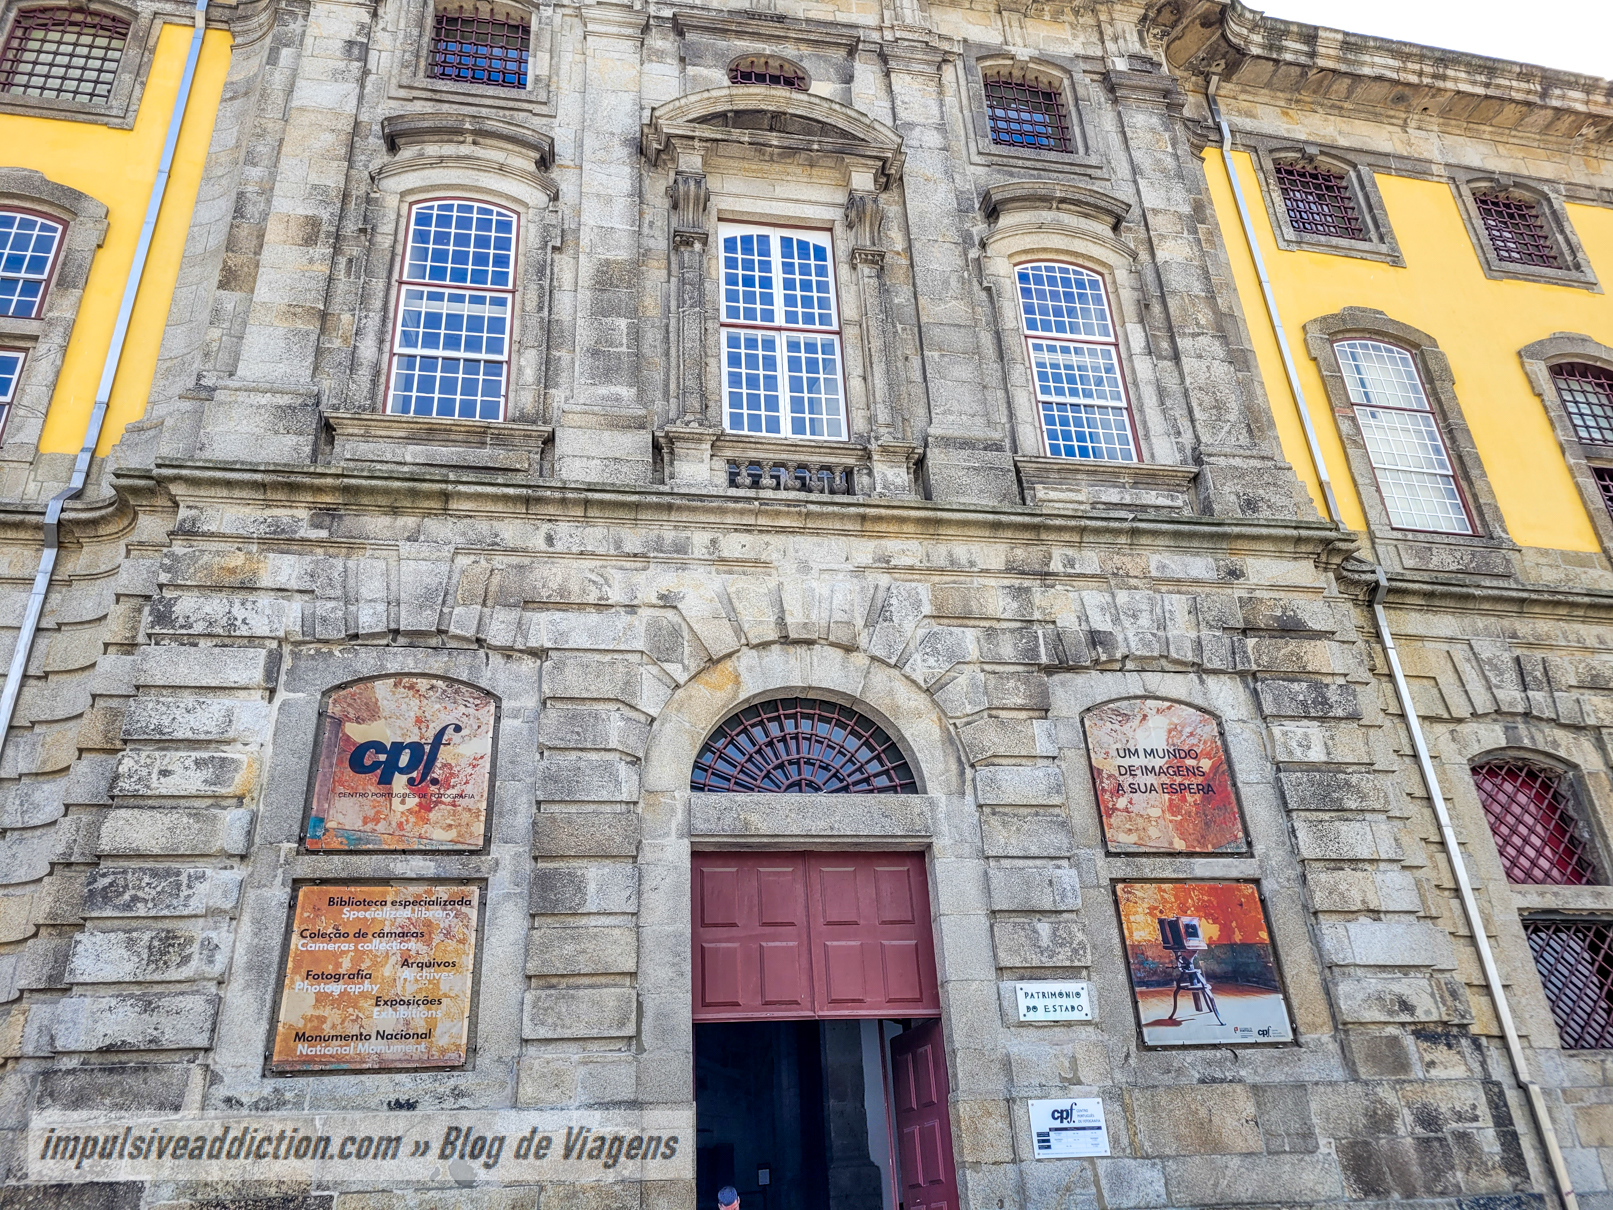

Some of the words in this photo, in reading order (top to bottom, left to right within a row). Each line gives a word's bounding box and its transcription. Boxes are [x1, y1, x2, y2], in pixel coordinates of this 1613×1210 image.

[1116, 747, 1140, 759] UM
[1143, 748, 1198, 760] MUNDO
[1117, 765, 1137, 776] DE
[1140, 765, 1206, 777] IMAGENS
[1116, 780, 1126, 794] À
[1129, 782, 1159, 794] SUA
[1161, 783, 1216, 795] ESPERA
[337, 791, 369, 799] CENTRO
[370, 790, 416, 800] PORTUGUÊS
[418, 792, 428, 800] DE
[430, 792, 475, 800] FOTOGRAFIA
[327, 896, 388, 908] Biblioteca
[390, 896, 472, 910] especializada
[341, 908, 410, 920] Specialized
[414, 908, 456, 920] library
[299, 928, 350, 942] Coleção
[353, 928, 368, 939] de
[371, 929, 425, 939] câmaras
[298, 940, 355, 951] Cameras
[357, 940, 416, 951] collection
[400, 958, 457, 971] Arquivos
[305, 970, 372, 983] Fotografia
[400, 970, 454, 981] Archives
[295, 981, 380, 995] Photography
[1024, 989, 1082, 999] PATRIMÓNIO
[374, 995, 442, 1008] Exposições
[372, 1008, 442, 1019] Exhibitions
[1026, 1005, 1038, 1013] DO
[1044, 1004, 1084, 1013] ESTADO
[293, 1031, 372, 1043] Monumento
[375, 1029, 432, 1042] Nacional
[296, 1043, 354, 1055] National
[356, 1042, 426, 1054] Monument
